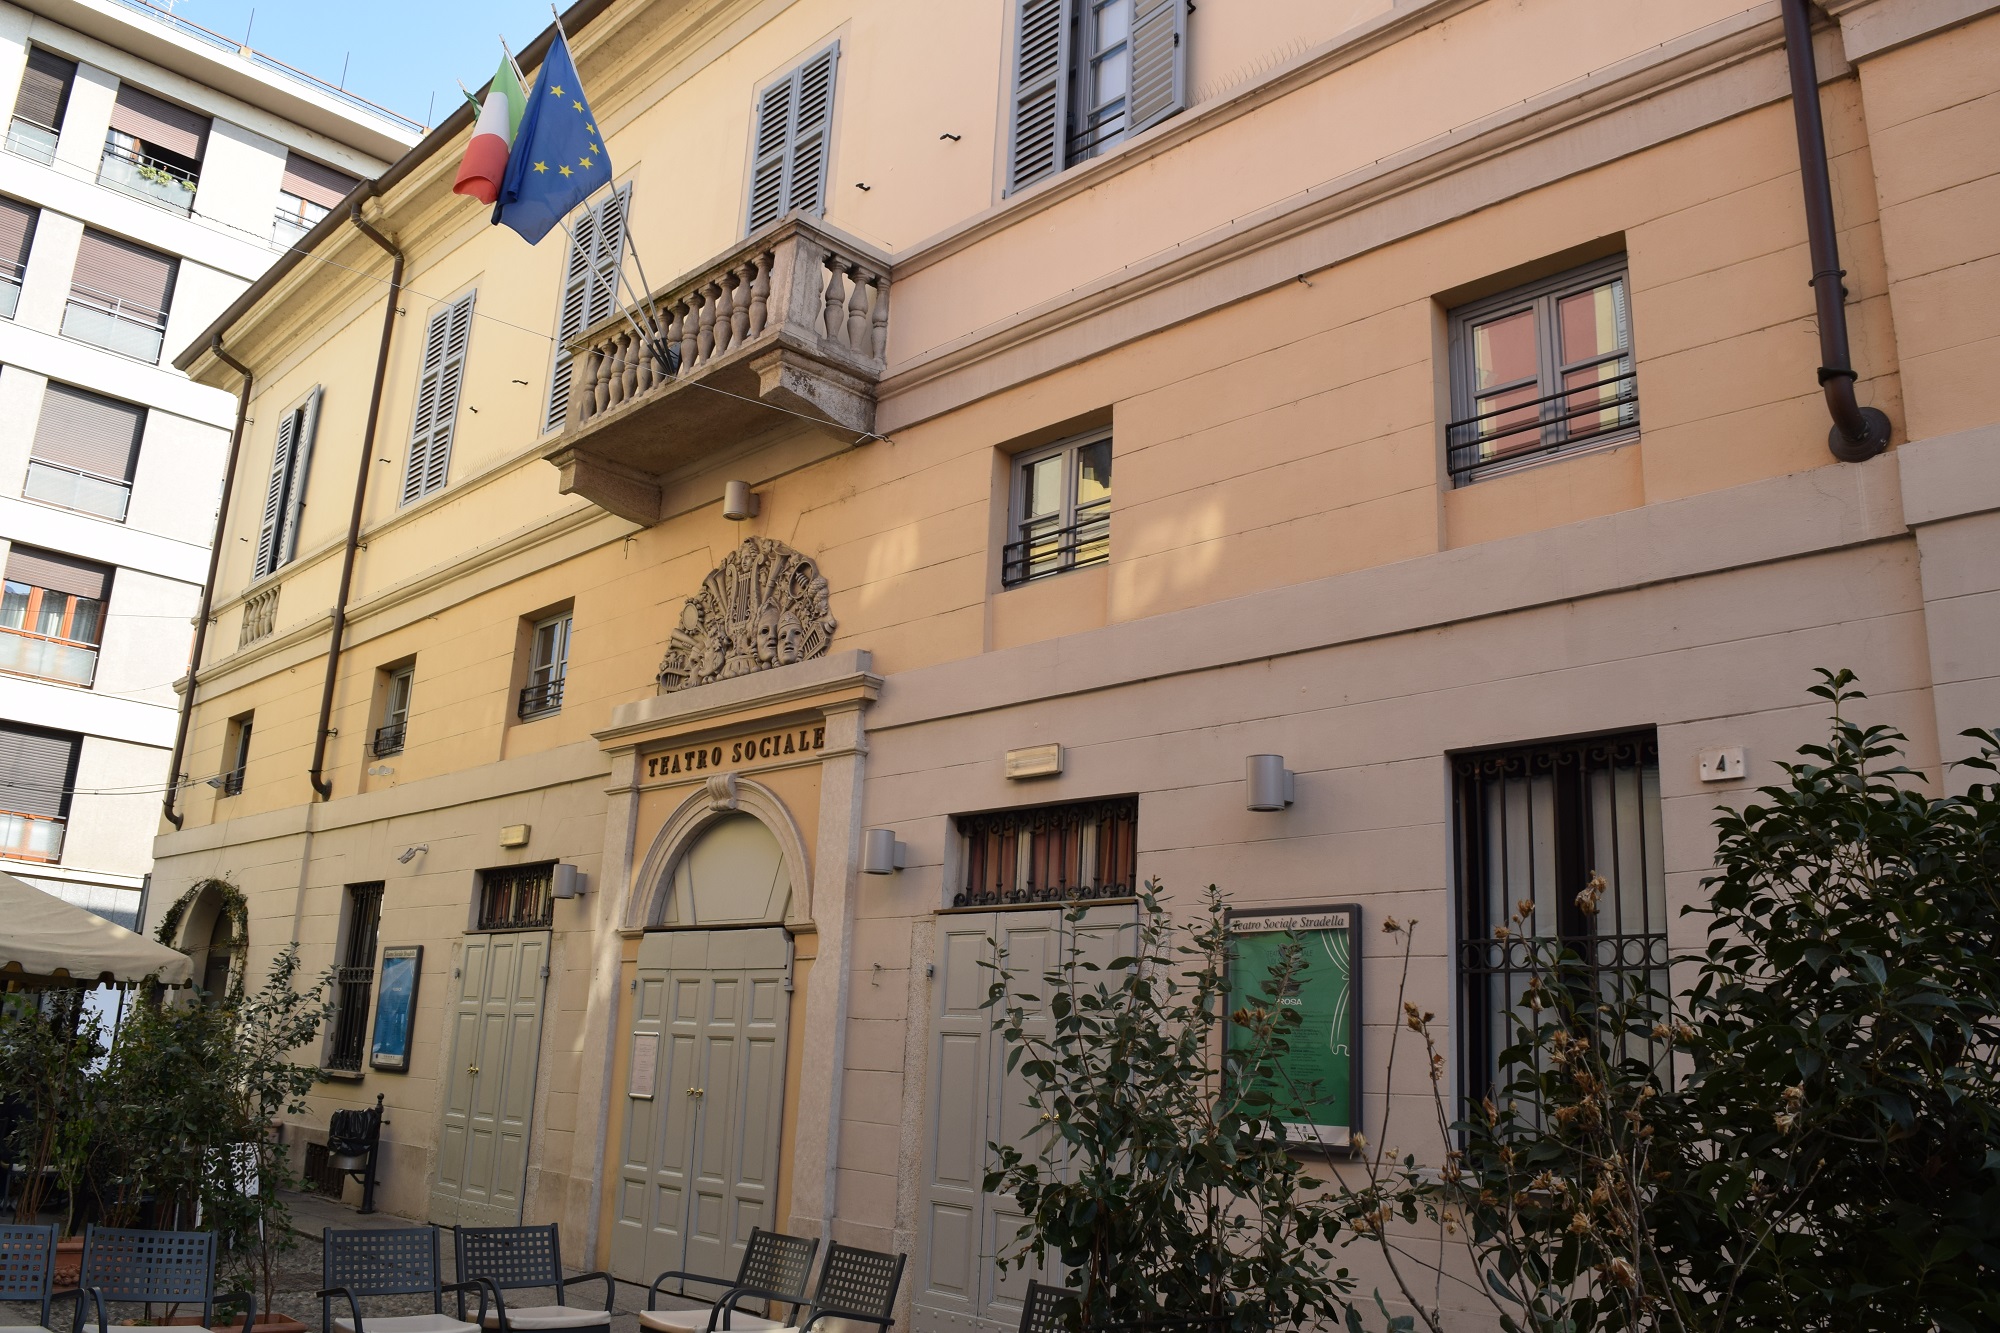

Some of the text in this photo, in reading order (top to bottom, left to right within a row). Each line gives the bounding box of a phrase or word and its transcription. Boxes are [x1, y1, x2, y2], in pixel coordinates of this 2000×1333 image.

[649, 727, 825, 777] TEATRO SOCIALE
[1716, 754, 1726, 772] 4
[1263, 917, 1298, 929] Sociale
[1300, 914, 1344, 928] Stradella
